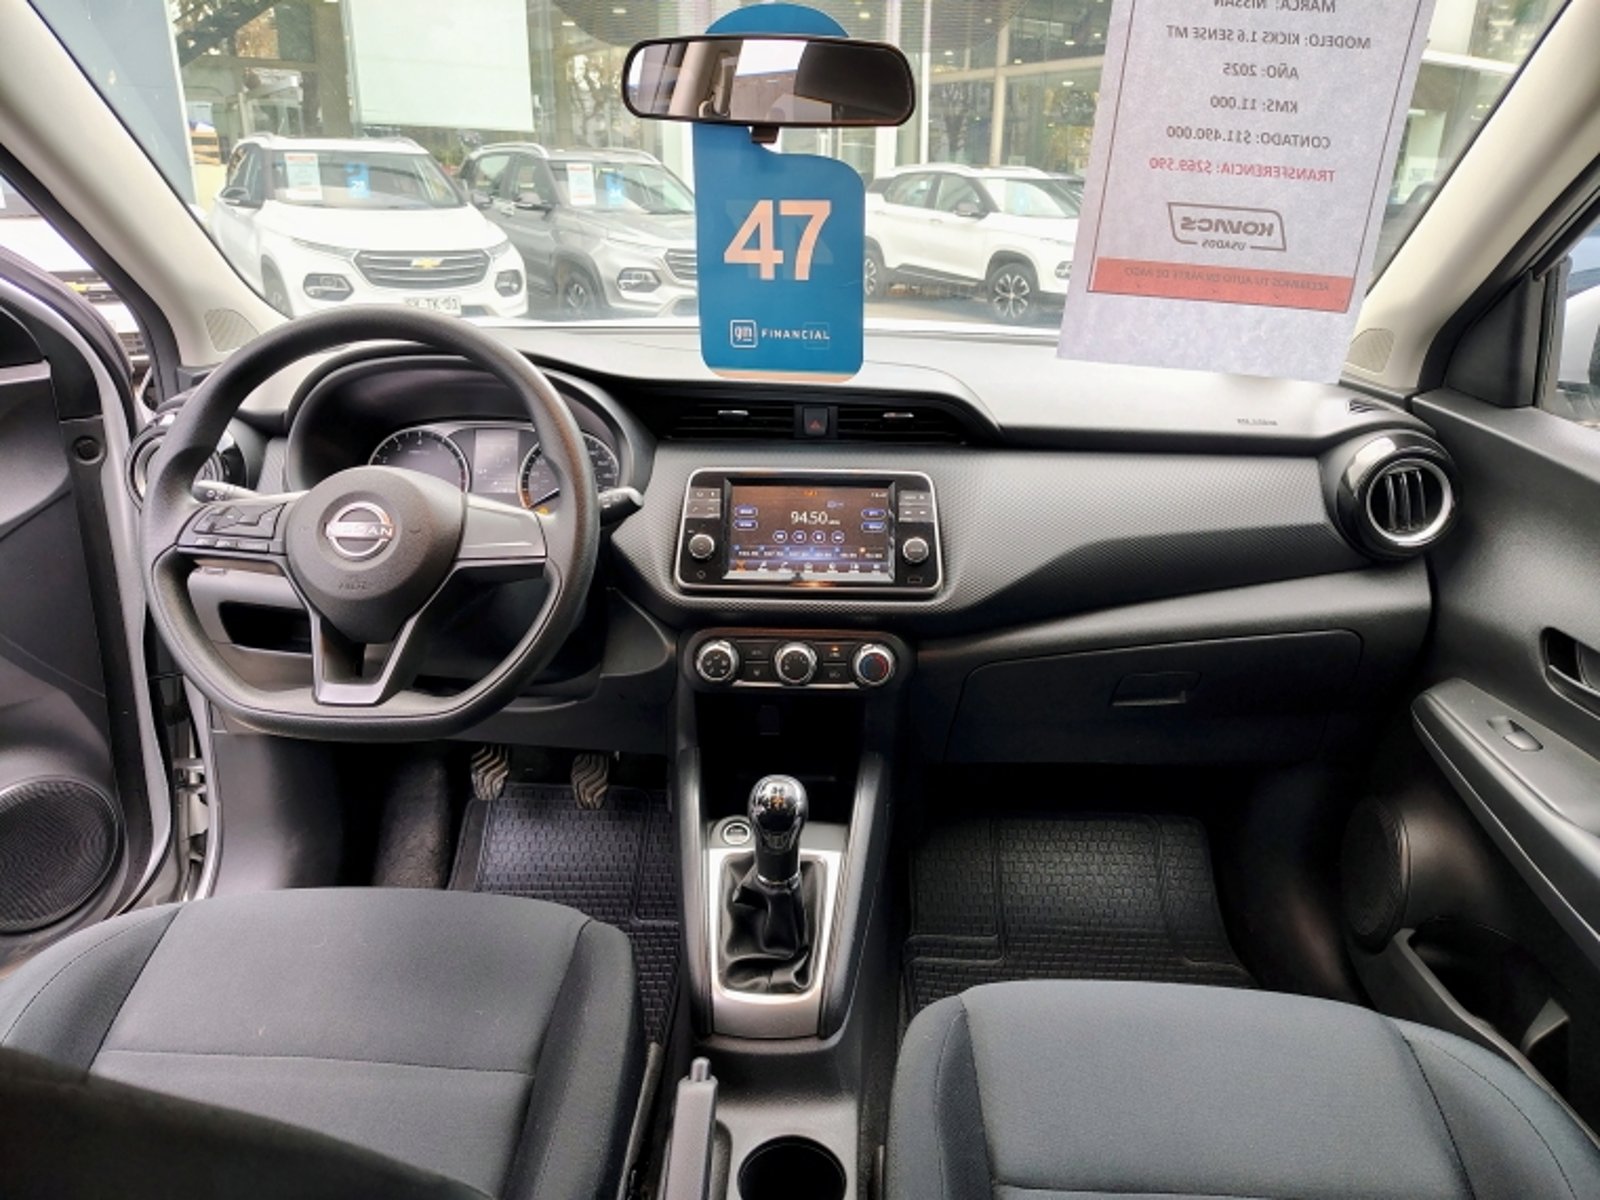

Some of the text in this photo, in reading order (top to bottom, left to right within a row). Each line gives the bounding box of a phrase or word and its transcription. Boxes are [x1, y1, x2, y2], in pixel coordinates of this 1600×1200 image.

[723, 199, 832, 281] 47
[734, 325, 830, 341] gm FINANCIAL
